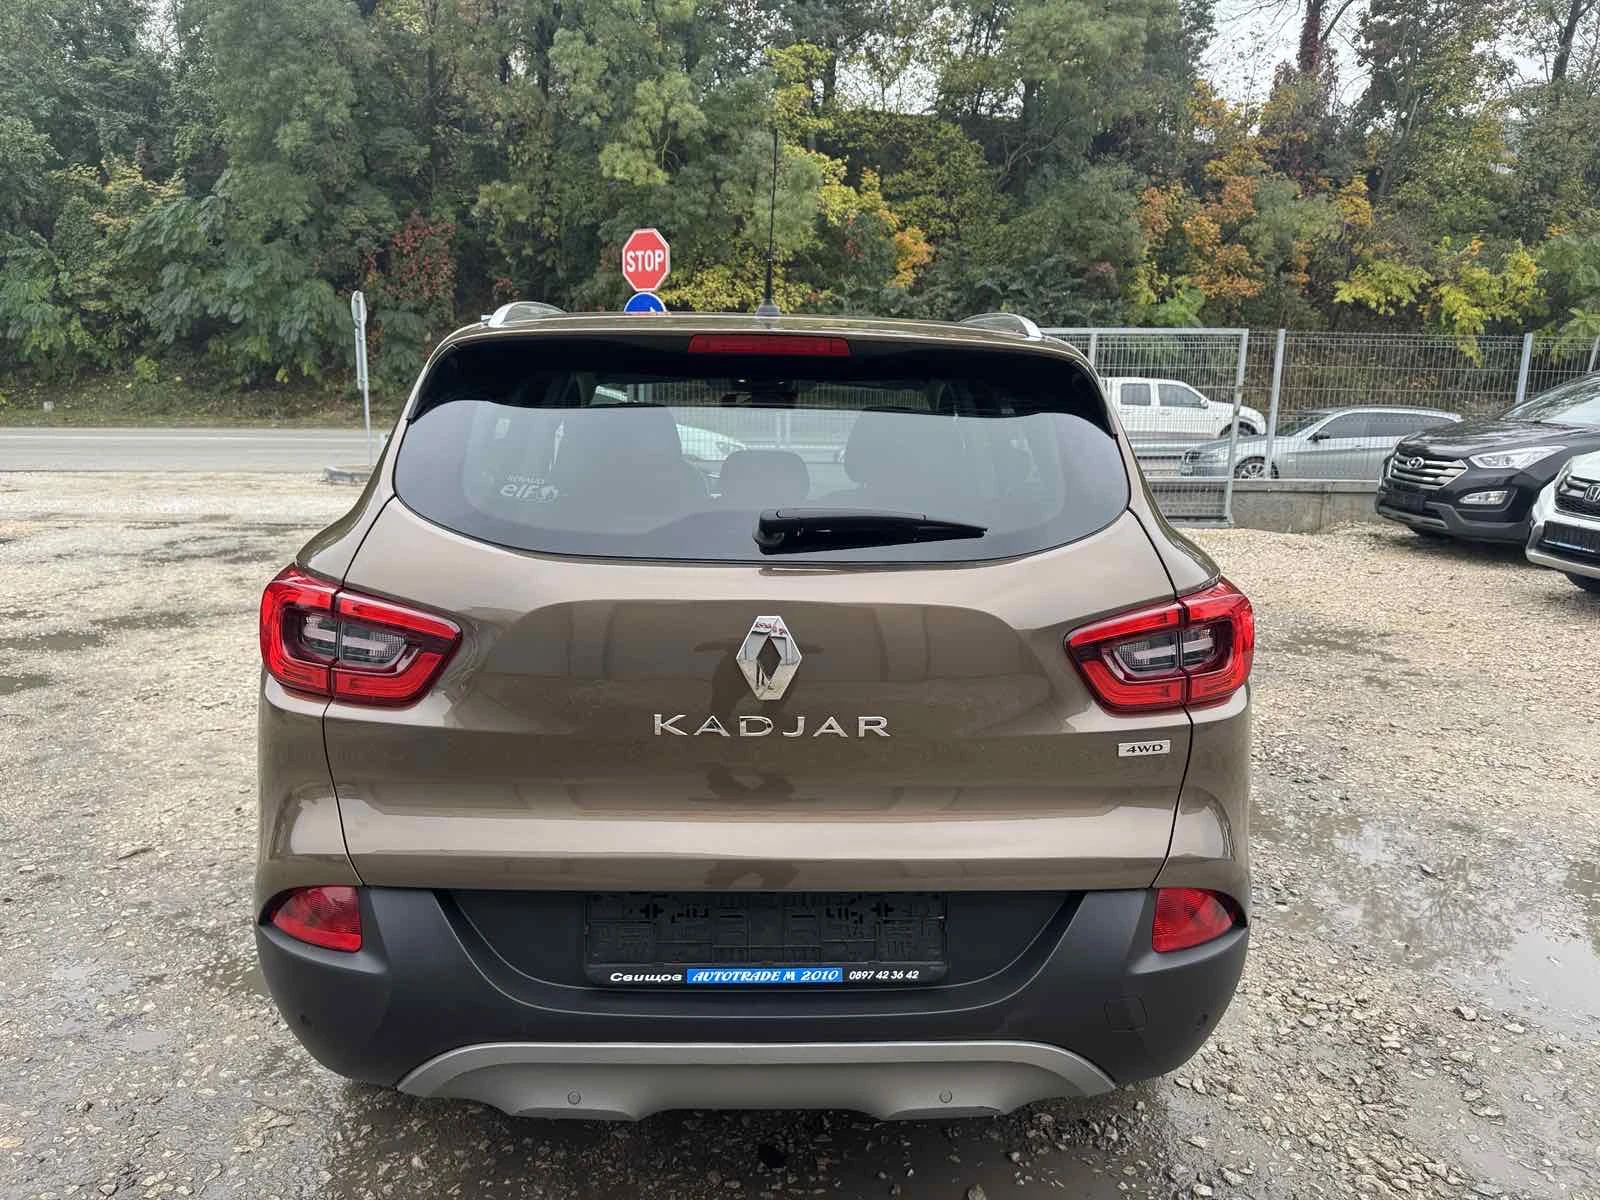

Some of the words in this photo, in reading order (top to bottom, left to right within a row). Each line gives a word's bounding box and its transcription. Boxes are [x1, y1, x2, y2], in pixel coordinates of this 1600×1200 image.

[626, 250, 664, 272] STOP
[653, 713, 891, 737] KADJAR
[1126, 744, 1164, 753] 4WD
[609, 972, 683, 983] Свищов
[692, 969, 780, 983] AUTOTRADE
[782, 970, 795, 982] M
[800, 970, 839, 981] 2010
[849, 971, 874, 981] 0897
[875, 971, 888, 981] 42
[890, 970, 903, 980] 36
[905, 970, 919, 980] 42
